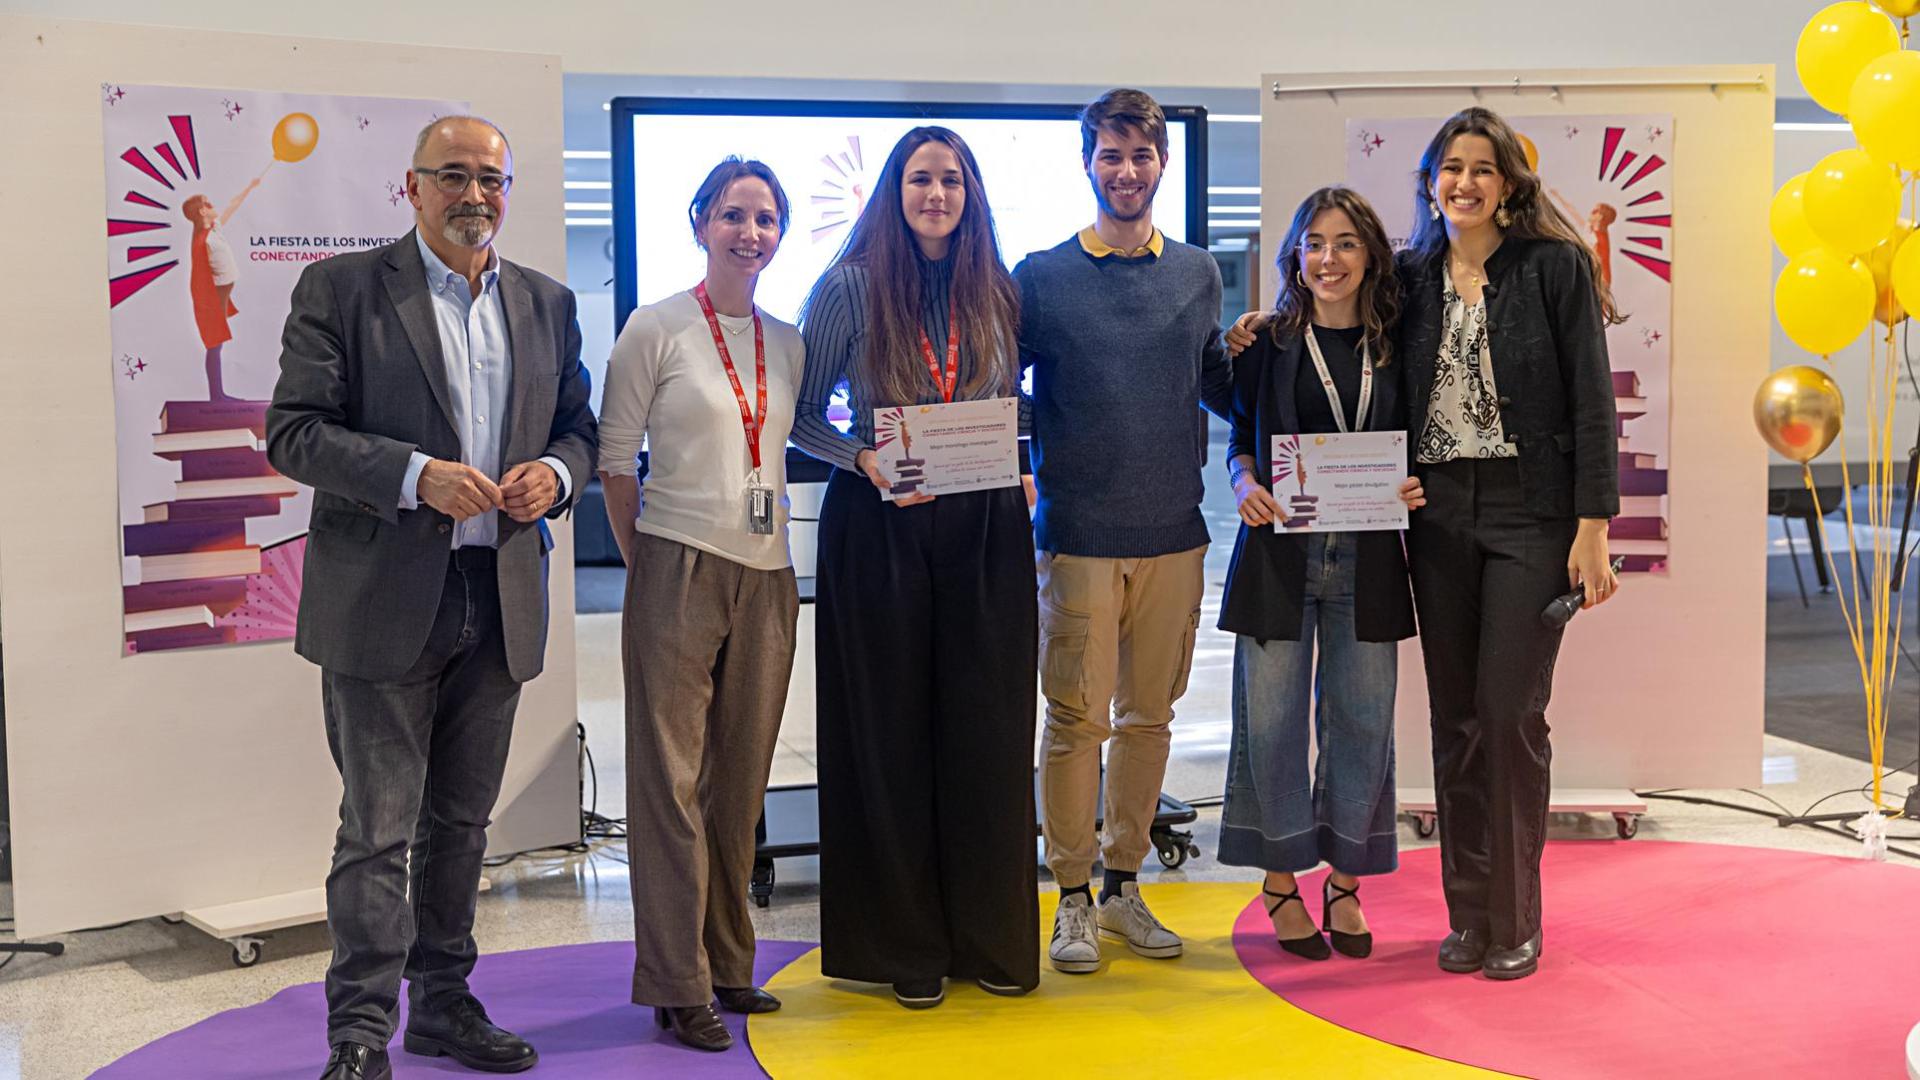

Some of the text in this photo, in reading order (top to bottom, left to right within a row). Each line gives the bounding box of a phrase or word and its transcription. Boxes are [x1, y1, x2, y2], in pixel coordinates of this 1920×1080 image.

[250, 236, 266, 246] LA
[269, 236, 311, 246] FIESTA
[313, 236, 330, 246] DE
[333, 237, 356, 247] LOS
